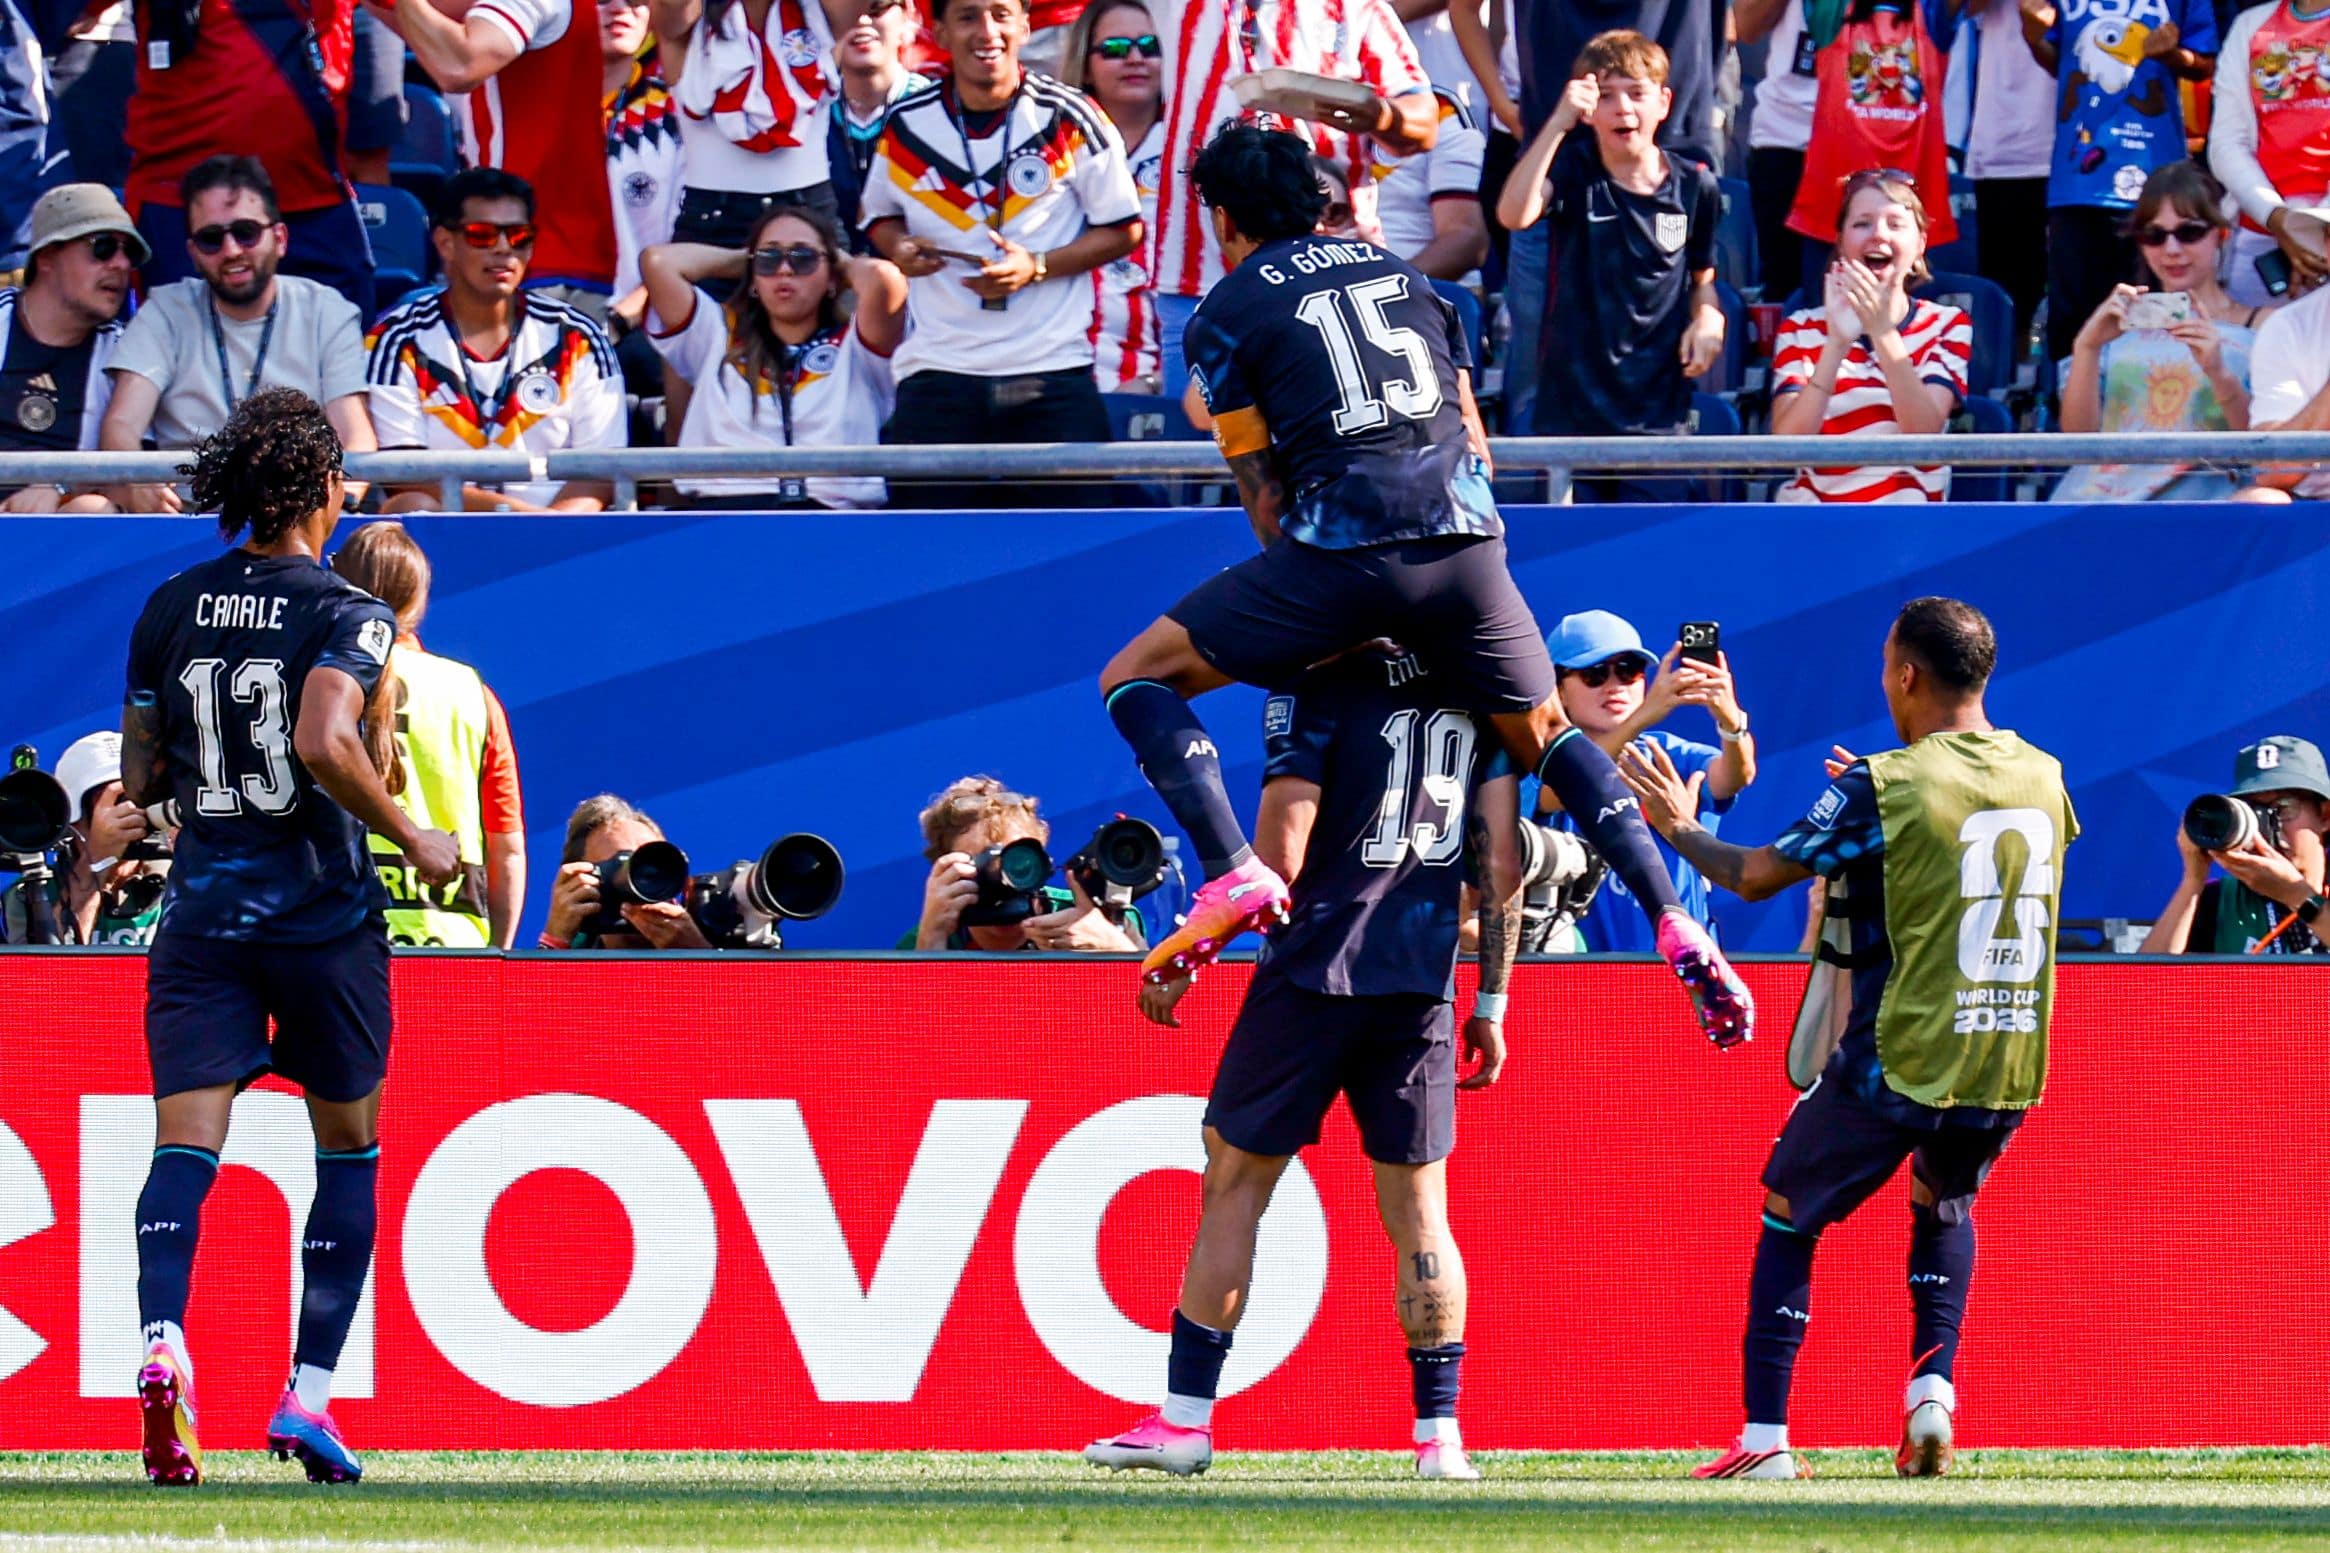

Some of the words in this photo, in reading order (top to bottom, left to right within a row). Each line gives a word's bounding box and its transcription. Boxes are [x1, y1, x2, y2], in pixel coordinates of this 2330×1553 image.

[1259, 264, 1295, 285] G.
[1290, 243, 1384, 274] GÓMEZ
[1294, 273, 1444, 436] 15
[195, 593, 289, 630] CANALE
[179, 658, 297, 816] 13
[1361, 708, 1478, 868] 19
[1983, 947, 2024, 966] FIFA
[1956, 988, 2012, 1006] WRLD
[2013, 989, 2042, 1005] CUP
[1953, 1007, 2038, 1033] 2026
[0, 1094, 1329, 1405] novo
[1410, 1251, 1440, 1282] 10
[1909, 1274, 1950, 1284] APF
